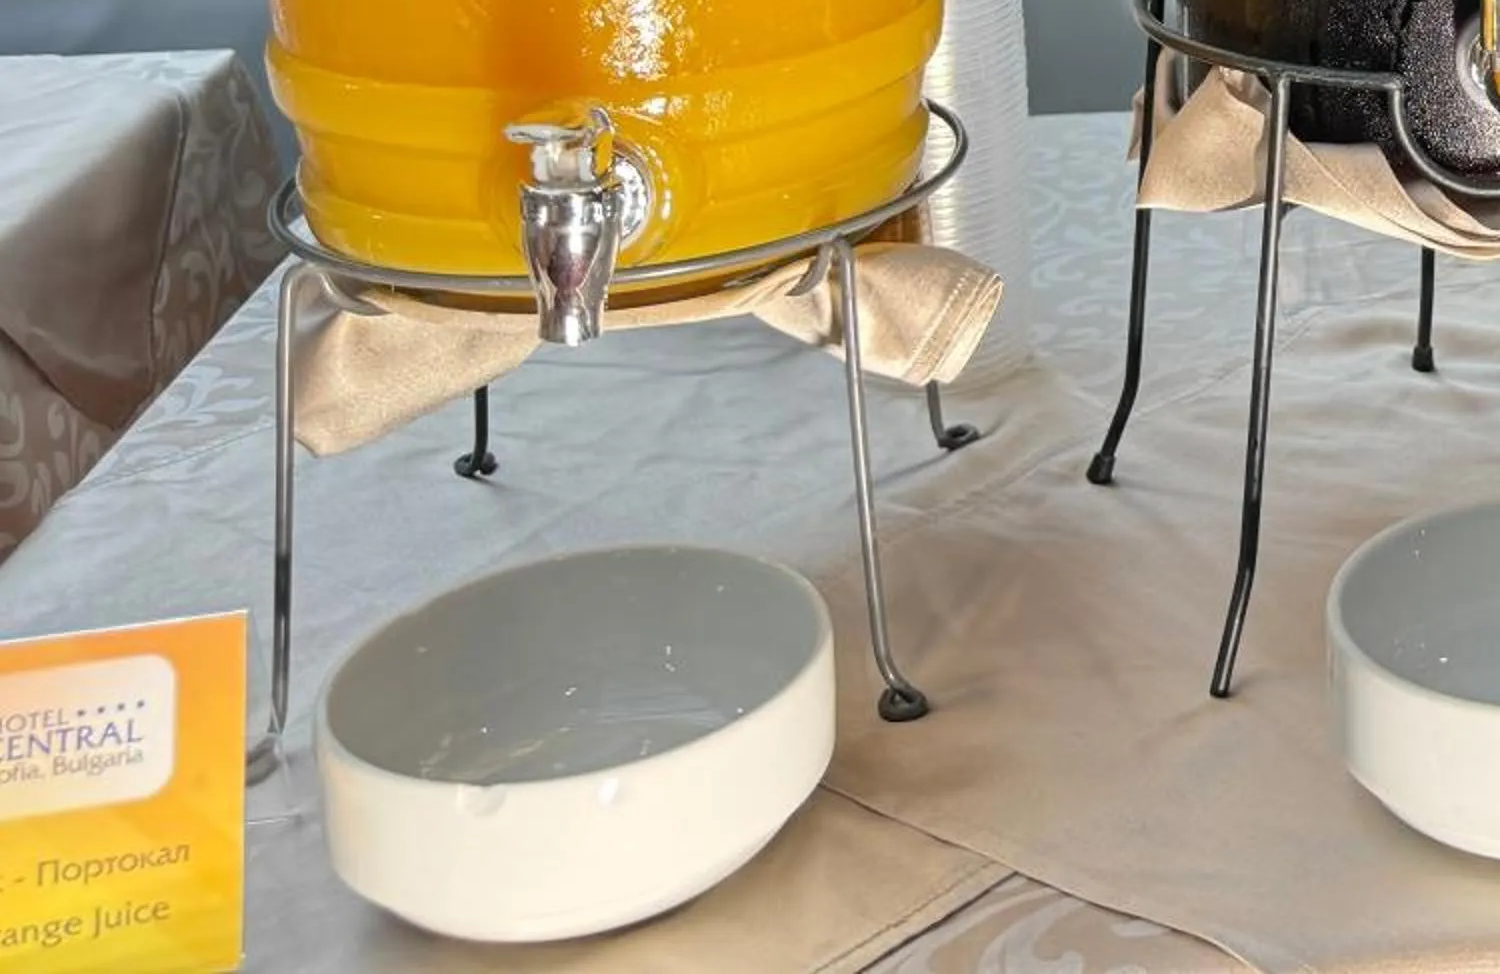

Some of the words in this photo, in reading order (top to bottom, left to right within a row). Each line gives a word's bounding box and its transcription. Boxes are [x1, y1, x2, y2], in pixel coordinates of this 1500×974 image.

[0, 708, 69, 735] OTEL
[0, 717, 144, 763] ENTRAL
[0, 761, 45, 785] ofia,
[52, 745, 144, 777] Bulgaria
[37, 843, 190, 887] Портокал
[0, 915, 83, 948] ange
[92, 900, 171, 939] Juice
